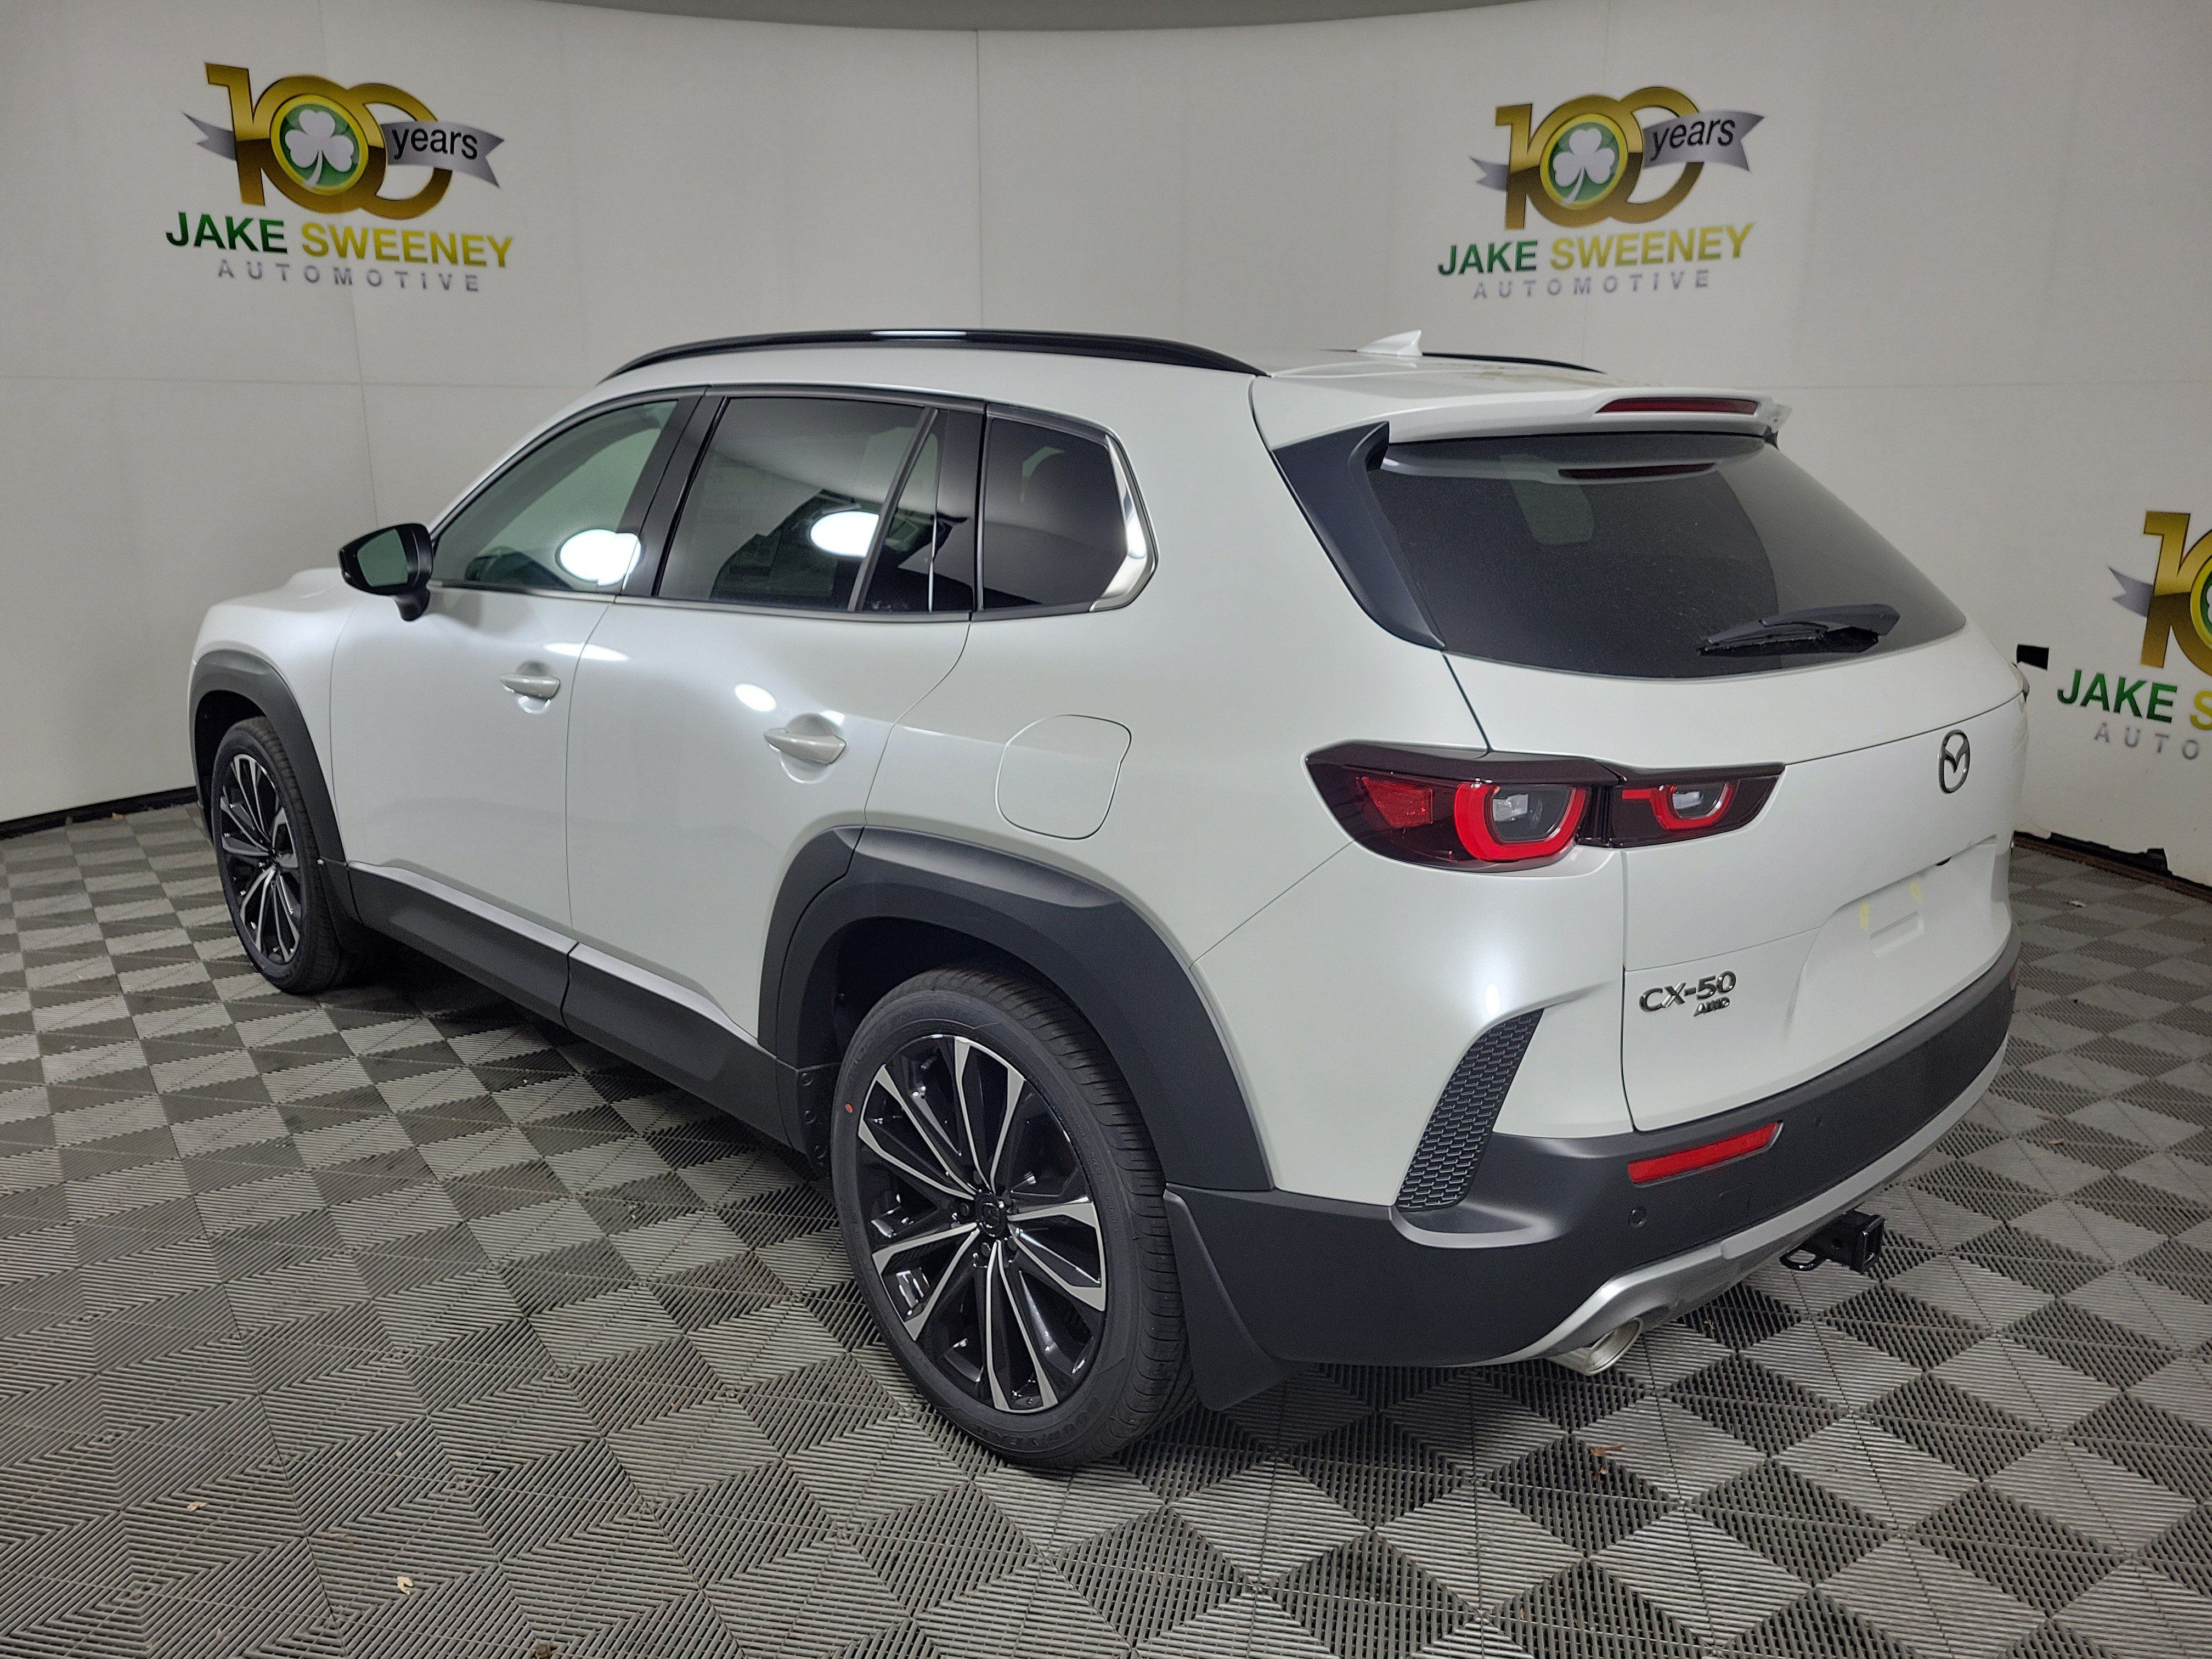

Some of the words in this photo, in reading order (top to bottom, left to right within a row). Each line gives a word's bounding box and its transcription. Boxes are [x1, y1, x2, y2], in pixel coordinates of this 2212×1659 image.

[204, 61, 453, 221] 100
[391, 126, 478, 160] years
[1496, 86, 1705, 229] 100
[1649, 117, 1735, 162] years
[166, 211, 288, 255] JAKE
[301, 222, 514, 268] SWEENEY
[1437, 239, 1538, 276] JAKE
[1549, 222, 1754, 271] SWEENEY
[217, 259, 479, 292] AUTOMOTIVE
[1473, 269, 1708, 300] AUTOMOTIVE
[2057, 668, 2177, 723] JAKE
[1639, 970, 1736, 1012] CX-50
